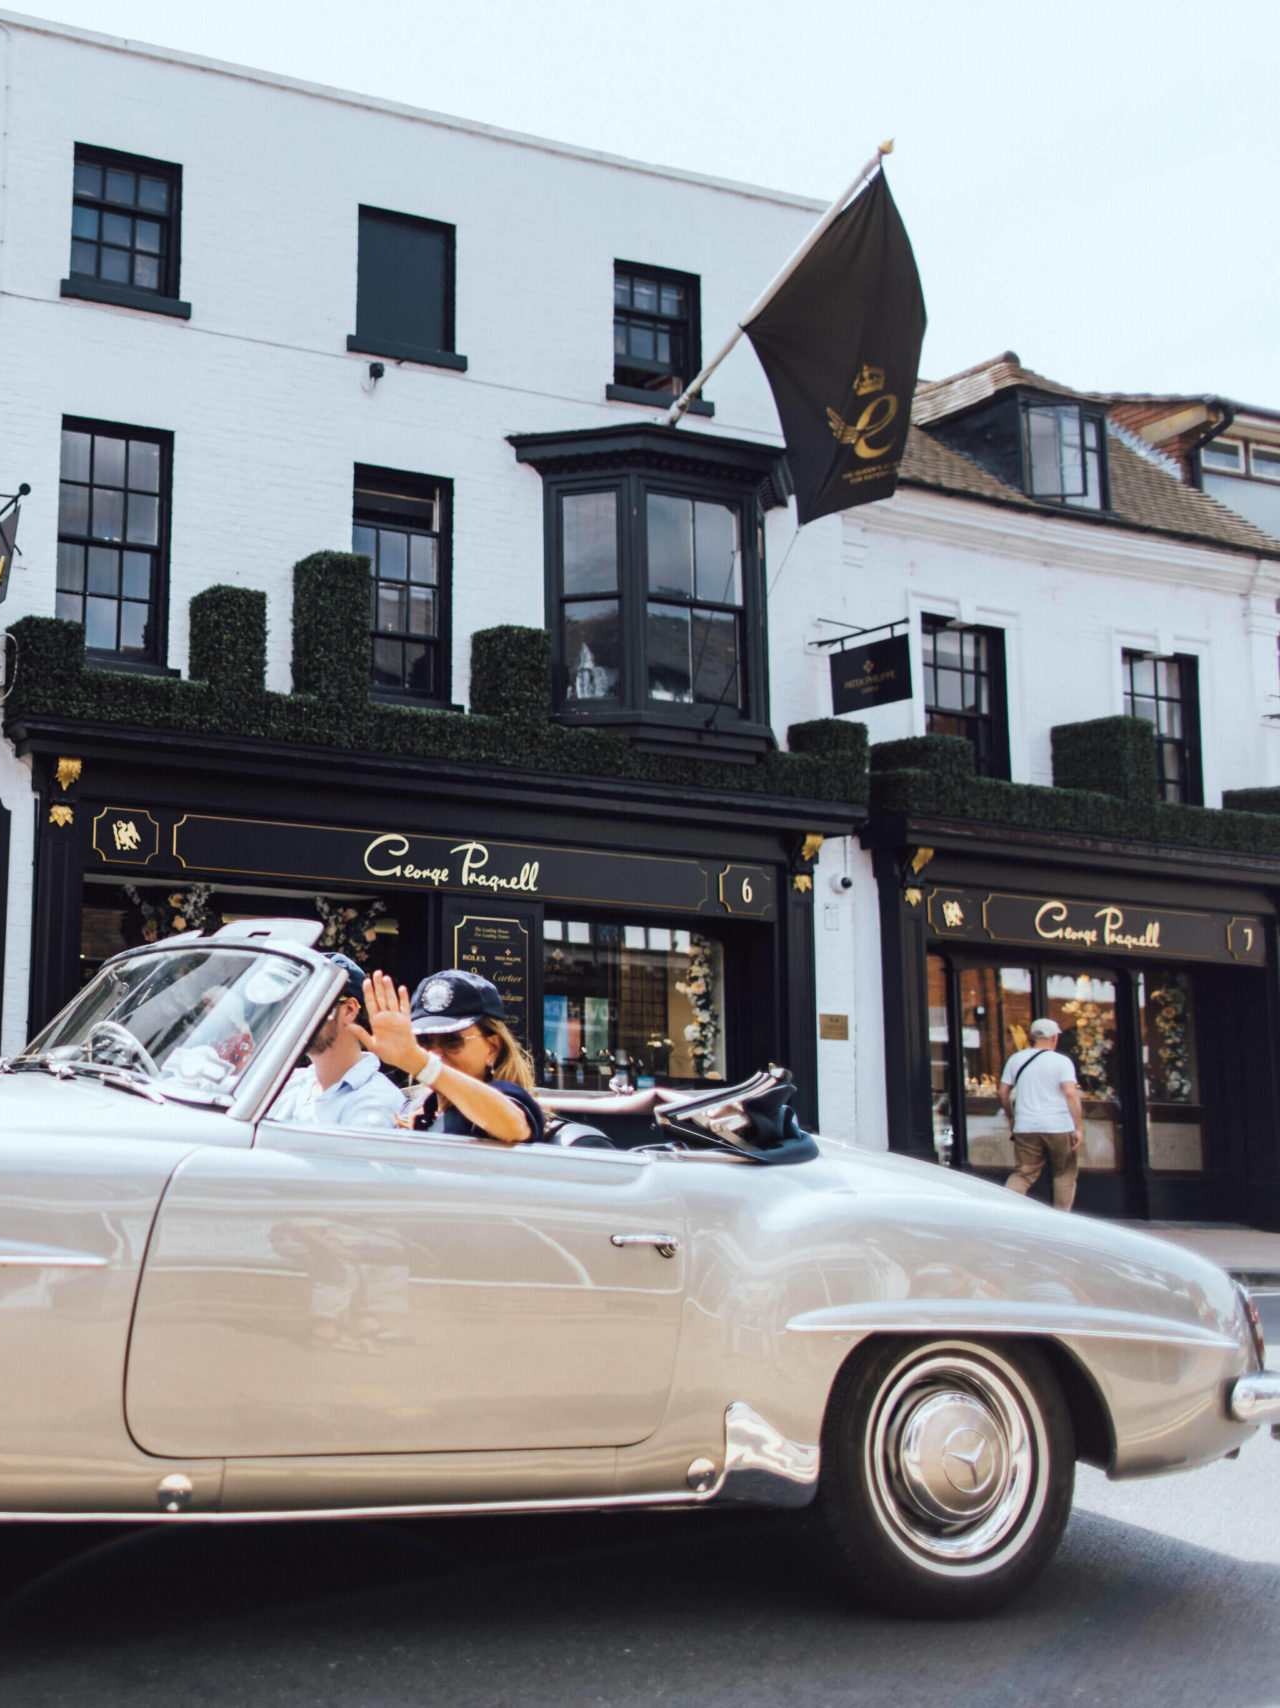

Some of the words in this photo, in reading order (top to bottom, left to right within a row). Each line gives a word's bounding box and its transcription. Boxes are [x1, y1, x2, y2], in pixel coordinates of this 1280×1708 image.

[364, 833, 449, 886] George
[450, 841, 539, 892] Pragnell
[742, 877, 753, 903] 6
[1035, 901, 1097, 946] George
[1094, 906, 1160, 949] Pragnell
[1243, 928, 1253, 951] 7
[462, 954, 486, 962] ROLEX
[493, 971, 523, 983] Cartier
